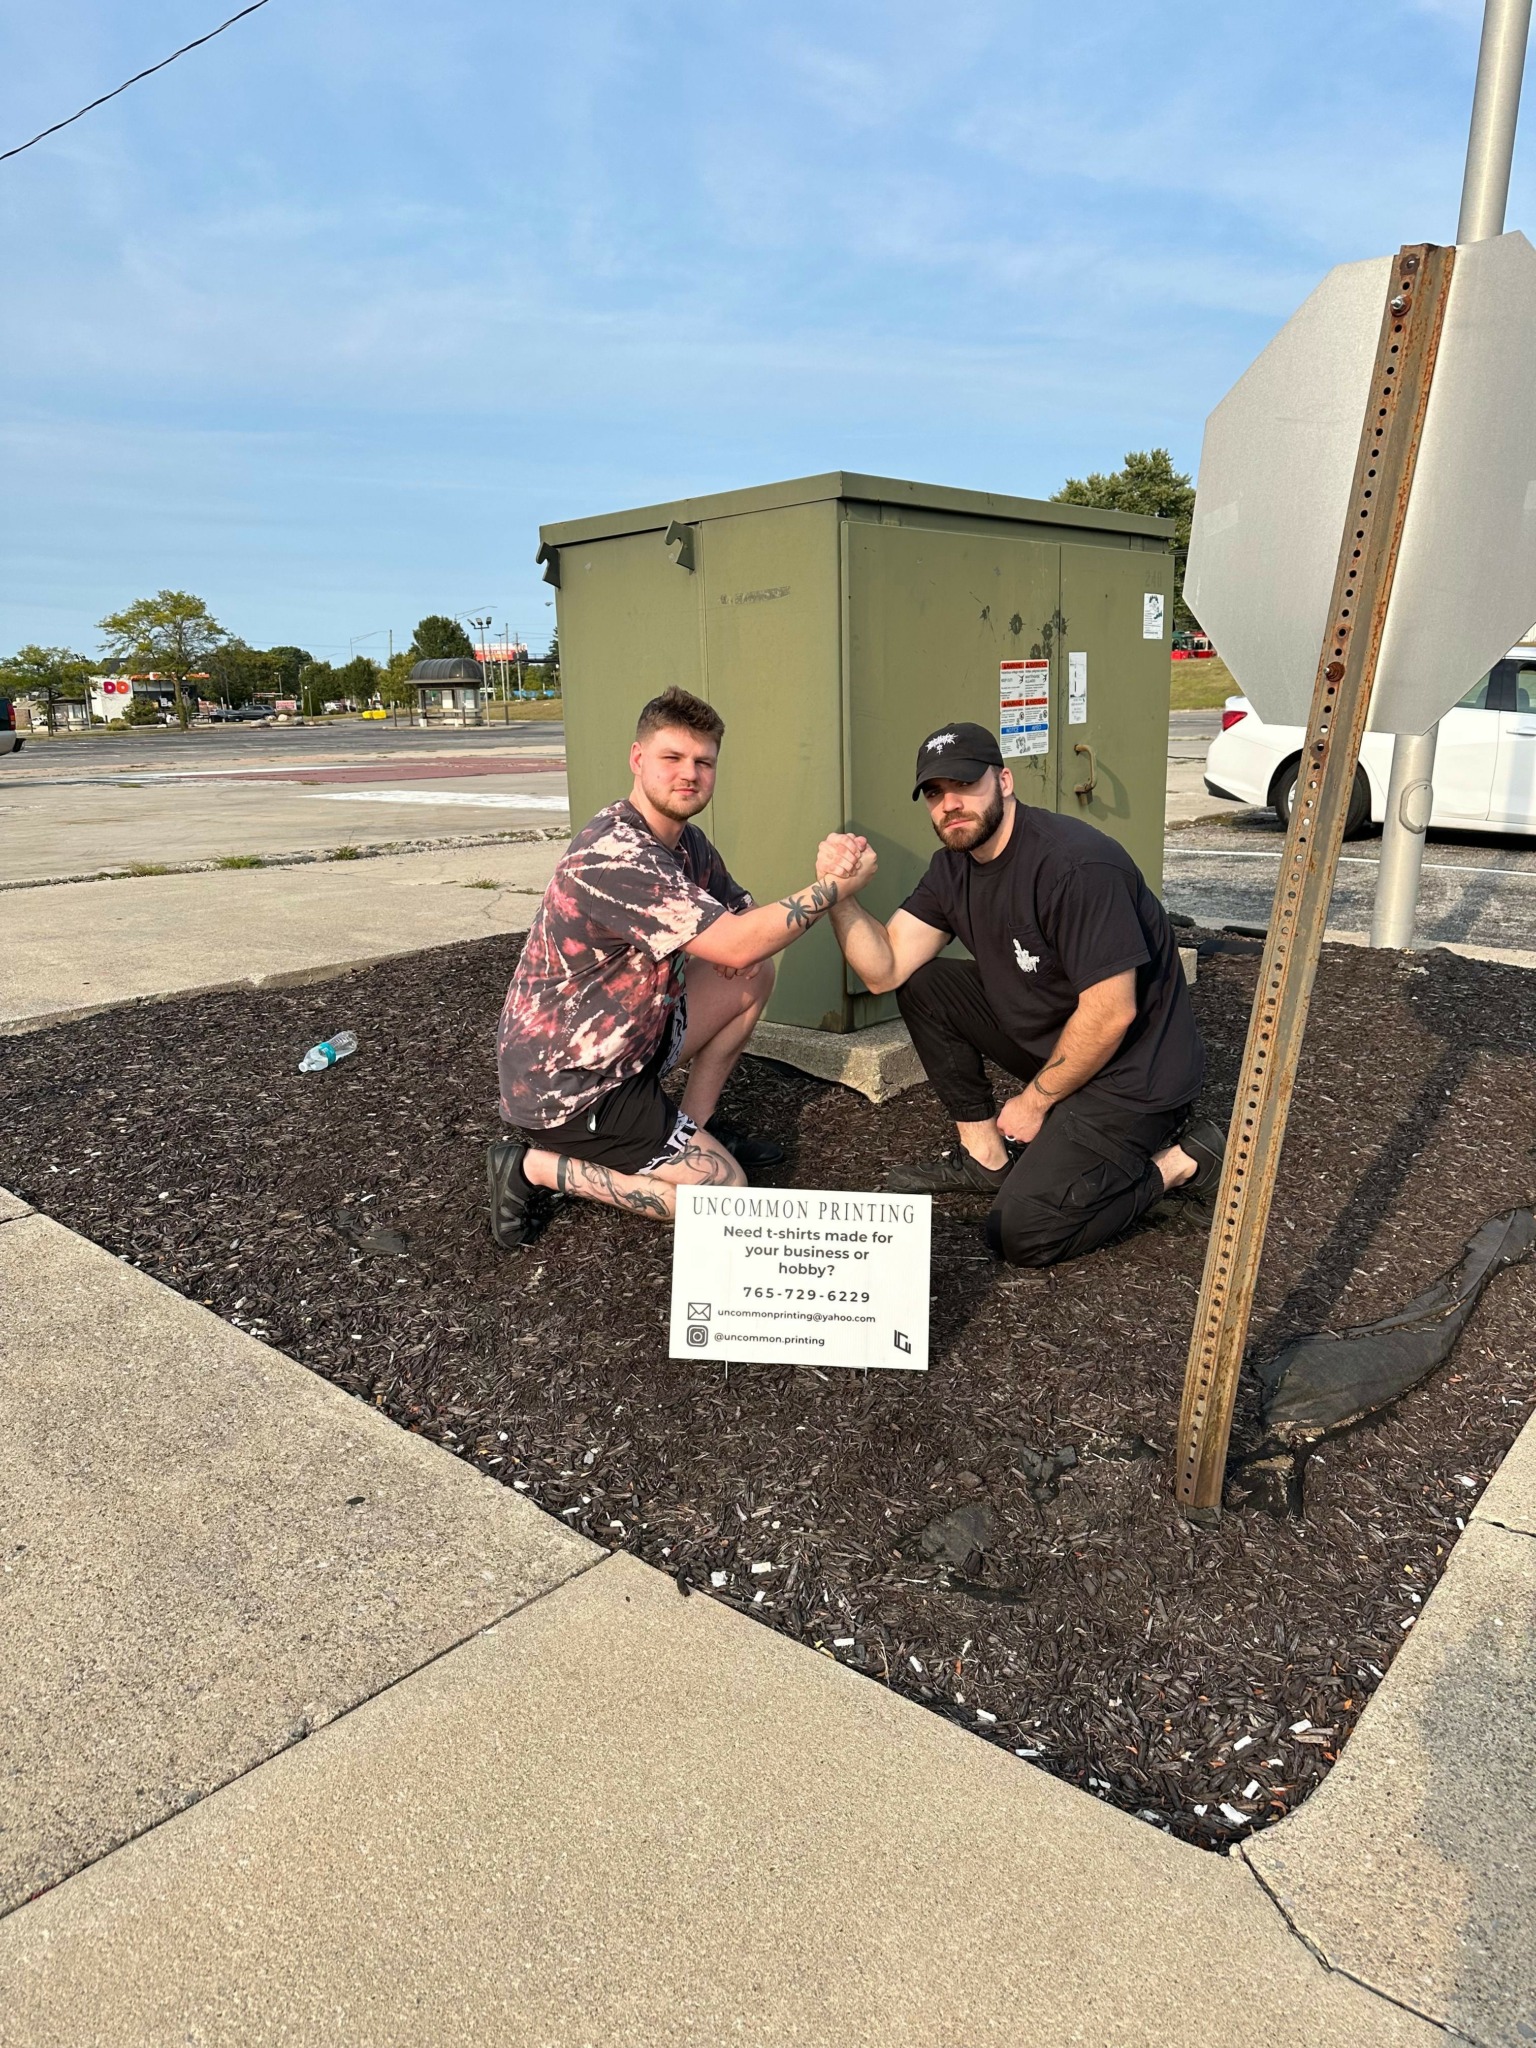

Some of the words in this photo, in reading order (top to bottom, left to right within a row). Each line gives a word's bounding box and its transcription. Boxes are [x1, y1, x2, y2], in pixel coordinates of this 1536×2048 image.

[693, 1196, 809, 1218] UNCOMMON
[818, 1202, 915, 1224] PRINTING
[723, 1225, 763, 1239] Need
[766, 1227, 821, 1241] t-shirts
[824, 1230, 868, 1243] made
[872, 1231, 894, 1244] for
[744, 1245, 780, 1258] your
[783, 1245, 850, 1260] business
[853, 1250, 870, 1260] or
[778, 1262, 836, 1279] hobby?
[743, 1286, 871, 1303] 765-729-6229
[717, 1308, 876, 1323] uncommonprinting@yahoo.com
[713, 1332, 826, 1347] @uncommon.printing
